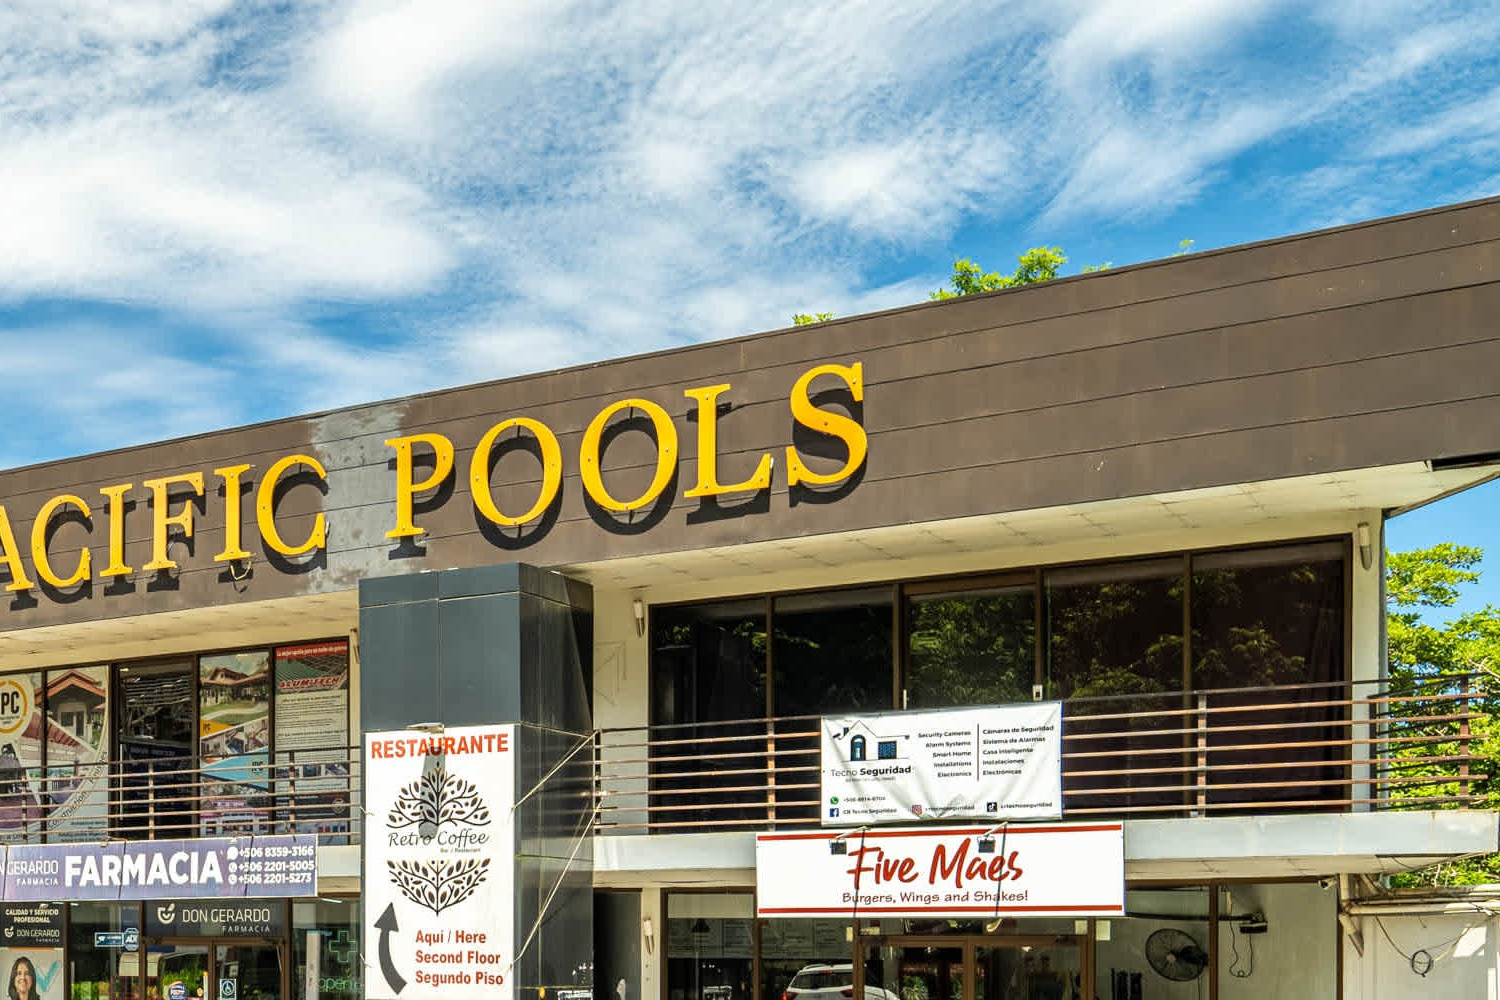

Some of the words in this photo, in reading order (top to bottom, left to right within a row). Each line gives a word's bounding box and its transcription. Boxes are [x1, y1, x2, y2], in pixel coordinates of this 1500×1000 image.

[384, 361, 868, 539] POOLS
[918, 731, 942, 739] Security
[944, 730, 971, 738] Cameras
[1021, 725, 1054, 735] Seguridad
[371, 733, 509, 759] RESTAURANTE
[999, 747, 1034, 756] Inteligente
[982, 758, 1025, 766] Instalaciones
[860, 765, 911, 777] Seguridad
[388, 832, 432, 847] Retro
[437, 827, 490, 848] Coffee
[239, 847, 263, 857] +506
[265, 845, 314, 857] 8359-3166
[7, 860, 59, 875] GERARDO
[65, 850, 223, 888] FARMACIA
[239, 861, 262, 872] +506
[264, 860, 315, 872] 2201-5005
[846, 845, 919, 889] Five
[929, 838, 1024, 889] Maes
[17, 878, 59, 886] FARMACIA
[239, 873, 262, 884] +506
[264, 872, 312, 884] 2201-5273
[842, 891, 896, 904] Burgers,
[900, 891, 940, 903] Wings
[944, 891, 970, 902] and
[973, 890, 1028, 902] Shakes!
[182, 909, 208, 923] DON
[211, 908, 270, 923] GERARDO
[17, 929, 30, 937] DON
[31, 929, 60, 937] GERARDO
[222, 925, 270, 933] FARMACIA
[415, 930, 444, 946] Aqui
[455, 930, 486, 943] Here
[415, 950, 463, 963] Second
[467, 950, 500, 964] Floor
[415, 970, 471, 987] Segundo
[475, 971, 504, 985] Piso
